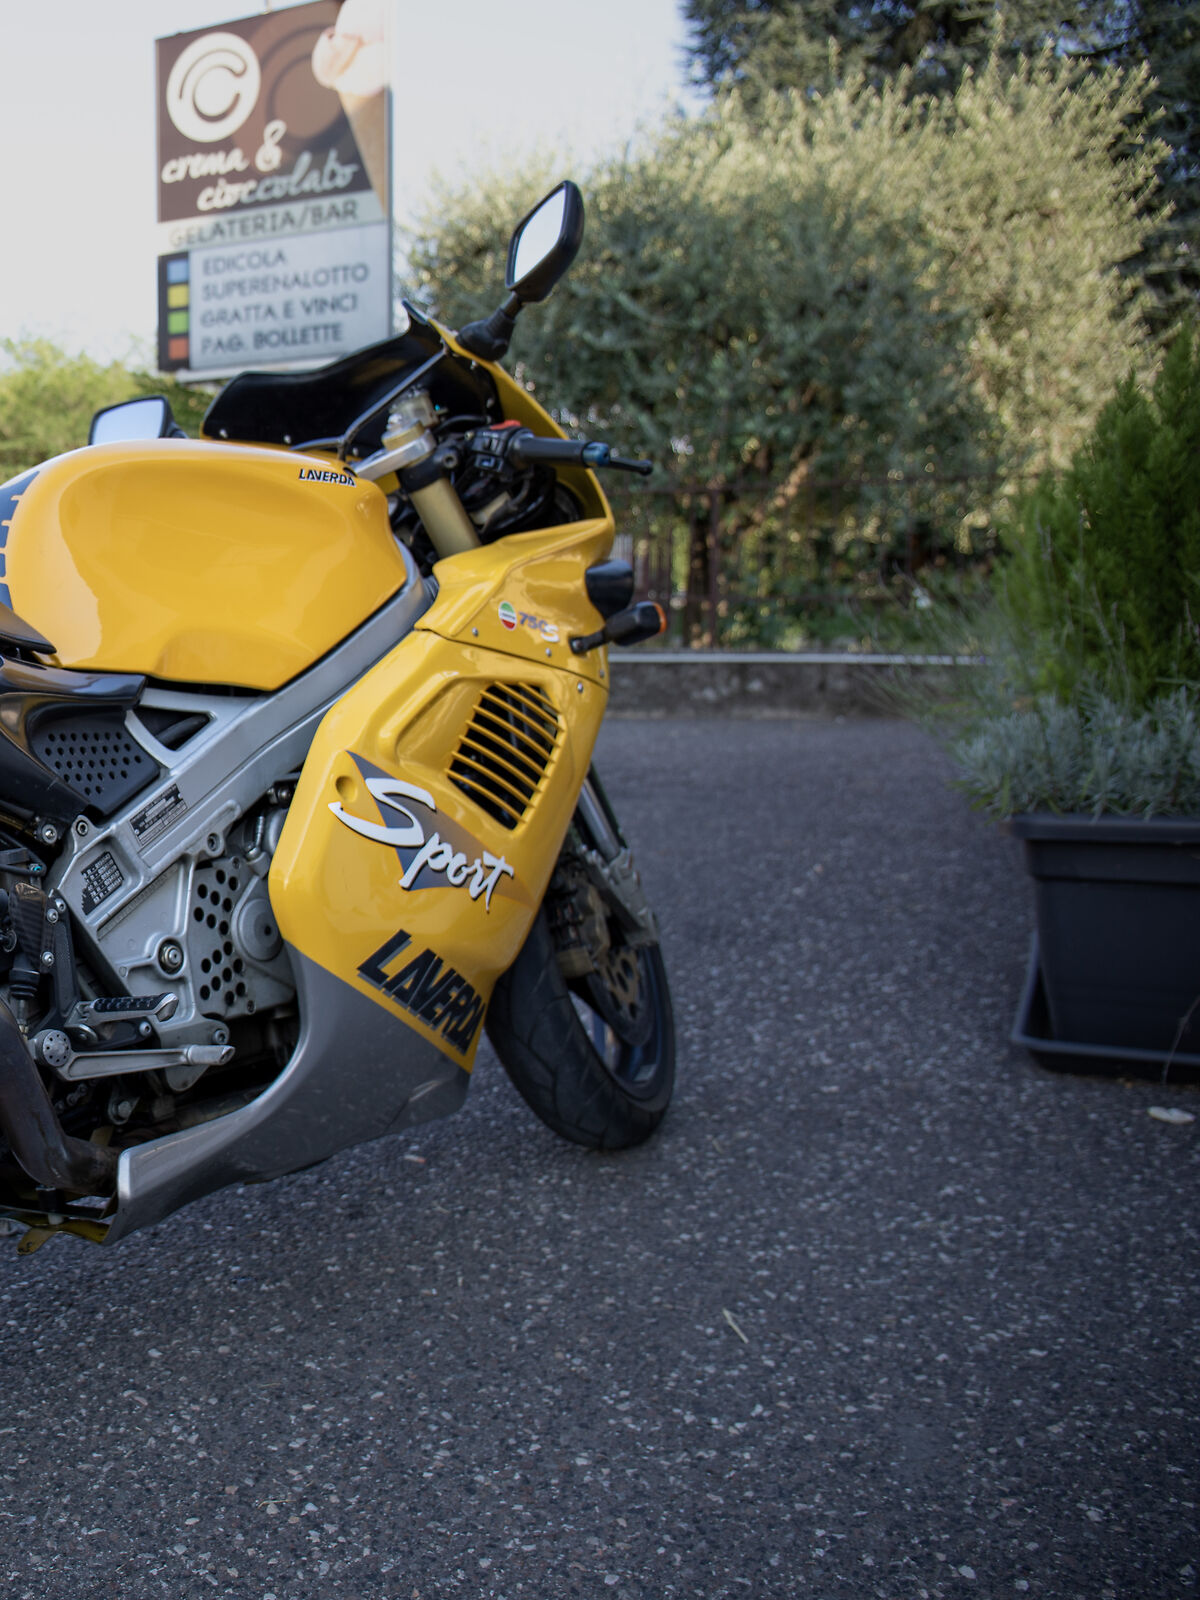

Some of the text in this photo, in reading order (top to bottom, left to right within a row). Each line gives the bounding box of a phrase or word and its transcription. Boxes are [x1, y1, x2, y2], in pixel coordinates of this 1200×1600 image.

[162, 120, 287, 183] crema &
[202, 250, 286, 276] EDICOLA
[202, 263, 370, 301] SUPERENALOTTO
[202, 293, 358, 327] GRATTA E VINCI
[254, 322, 343, 349] BOLLETTE
[299, 468, 356, 487] LAVERDA
[328, 778, 514, 913] Sport
[356, 929, 485, 1056] LAVERDA
